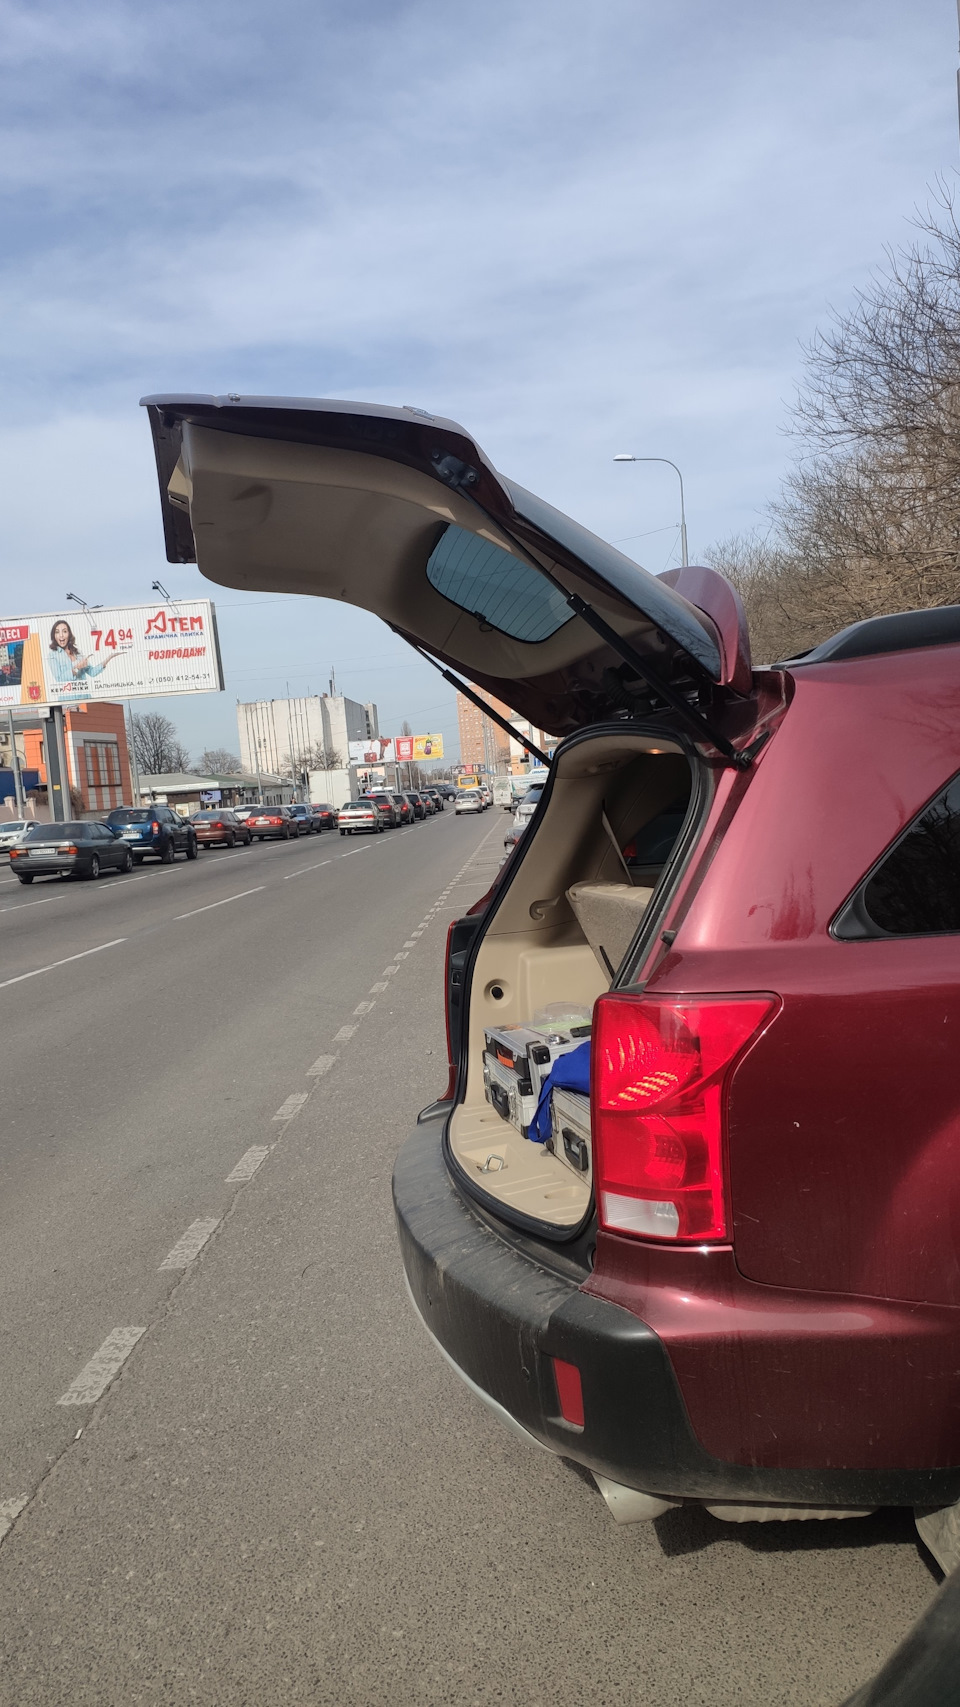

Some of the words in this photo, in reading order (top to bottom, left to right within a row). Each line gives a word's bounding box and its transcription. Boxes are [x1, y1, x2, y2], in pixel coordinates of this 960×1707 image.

[90, 629, 117, 651] 74
[118, 628, 133, 640] 94
[148, 646, 206, 660] РОЗПРОДАЖ!
[155, 676, 174, 684] (050)
[176, 673, 211, 682] 412-54-31
